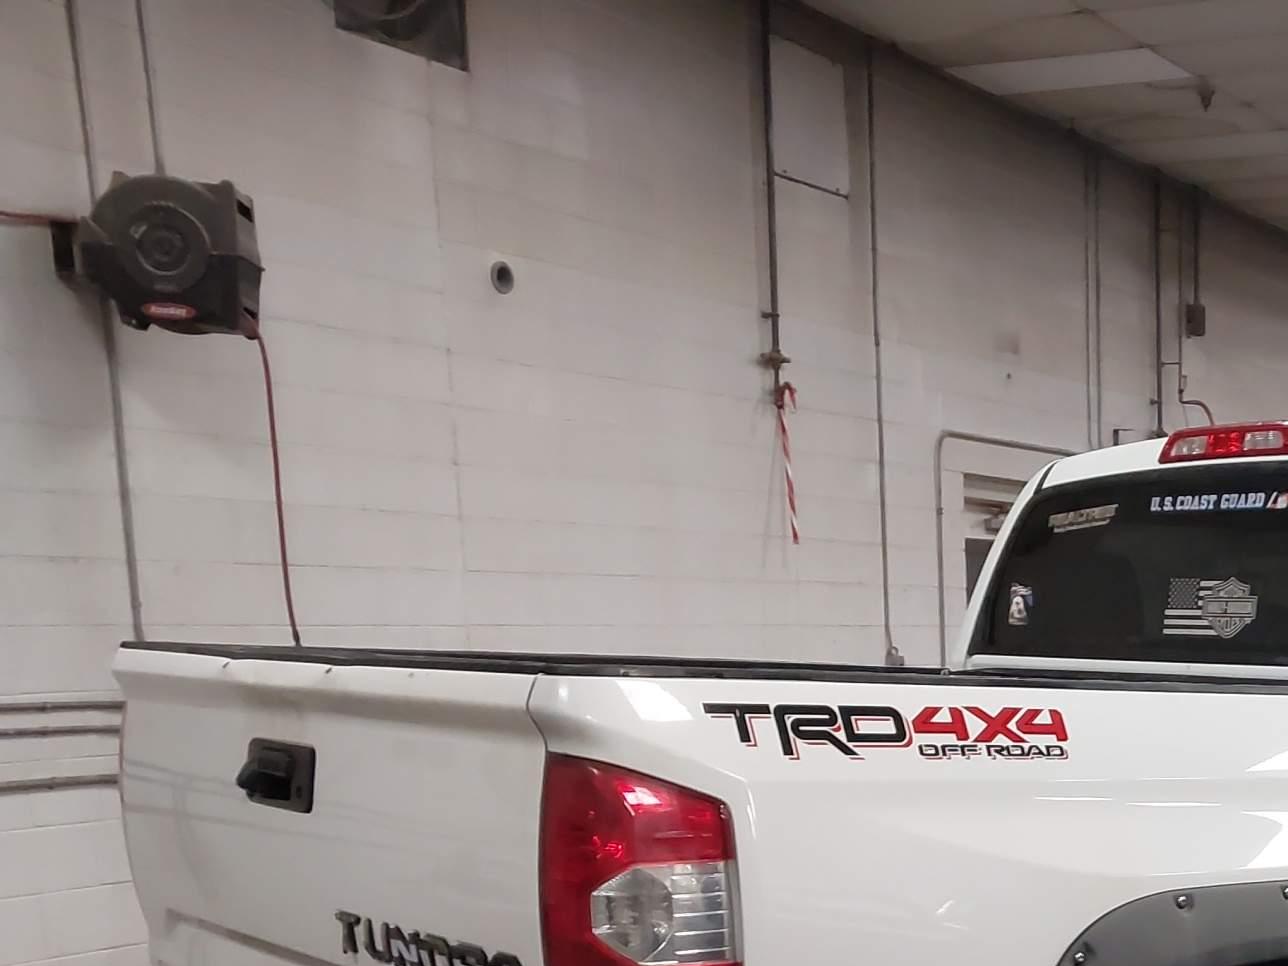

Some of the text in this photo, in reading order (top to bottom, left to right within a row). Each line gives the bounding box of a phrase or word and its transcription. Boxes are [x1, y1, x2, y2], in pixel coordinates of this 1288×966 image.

[1175, 494, 1218, 510] COAST
[1220, 492, 1265, 509] GUARD
[702, 702, 912, 760] TRD
[918, 743, 1069, 760] OFF ROAD
